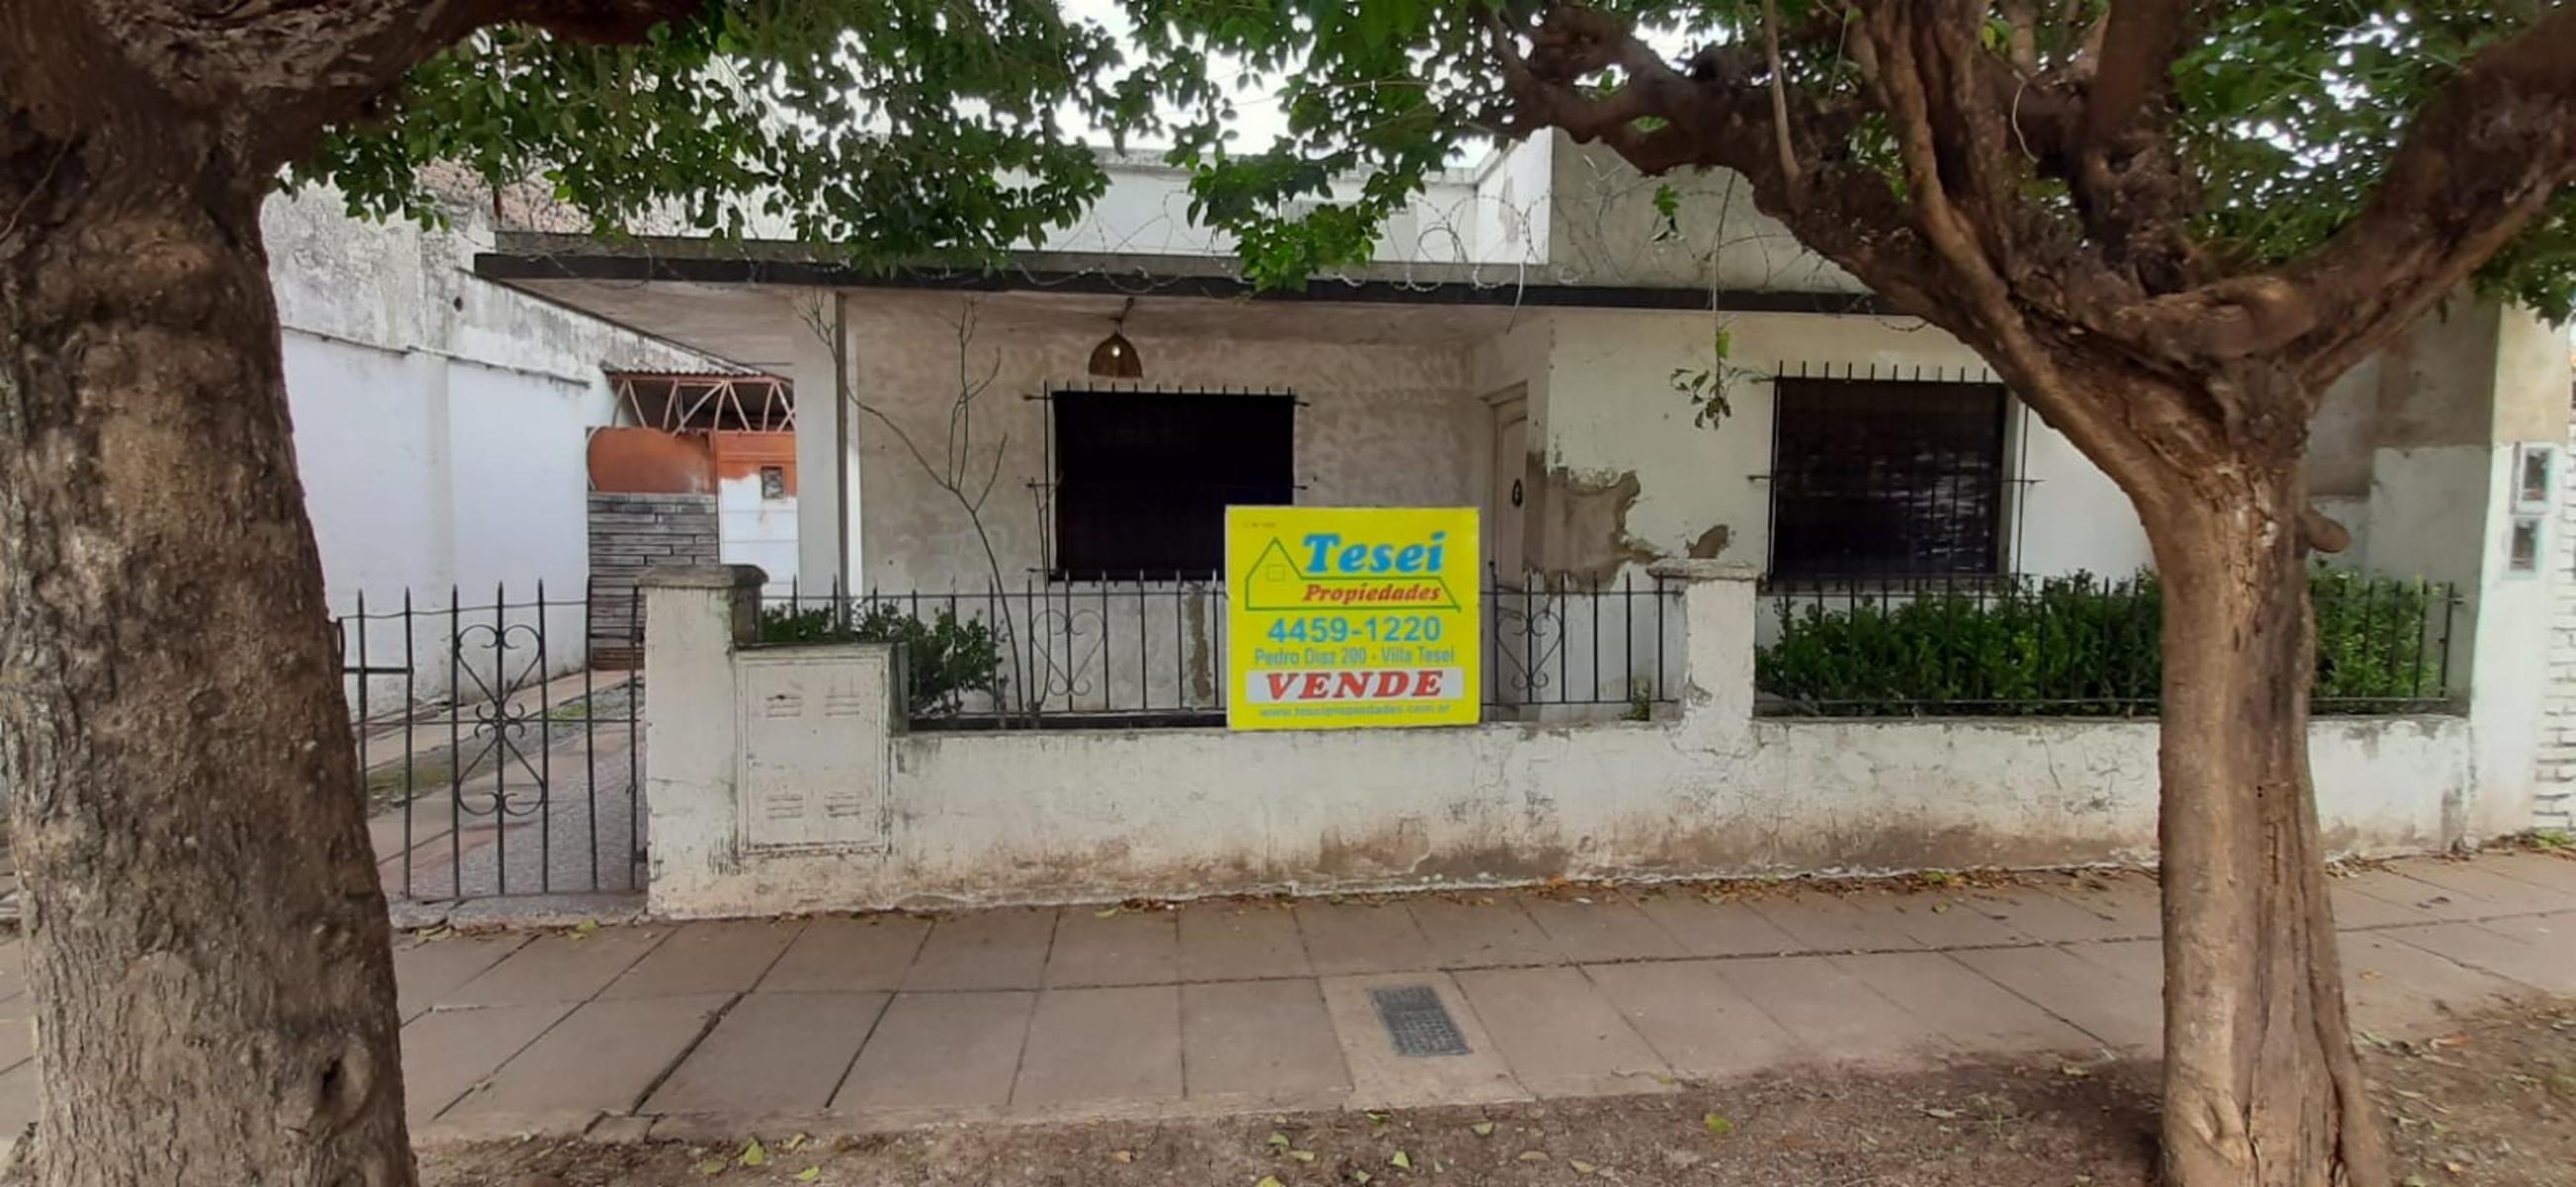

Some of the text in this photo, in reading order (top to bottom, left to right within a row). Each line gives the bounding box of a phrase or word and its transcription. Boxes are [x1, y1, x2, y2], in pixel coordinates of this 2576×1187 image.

[1303, 531, 1446, 573] Tesei
[1303, 583, 1441, 604] Propiedades
[1268, 616, 1443, 643] 4459-1220
[1255, 648, 1298, 665] Pedro
[1381, 646, 1412, 663] Villa
[1418, 645, 1454, 662] Tesei
[1266, 670, 1444, 699] VENDE
